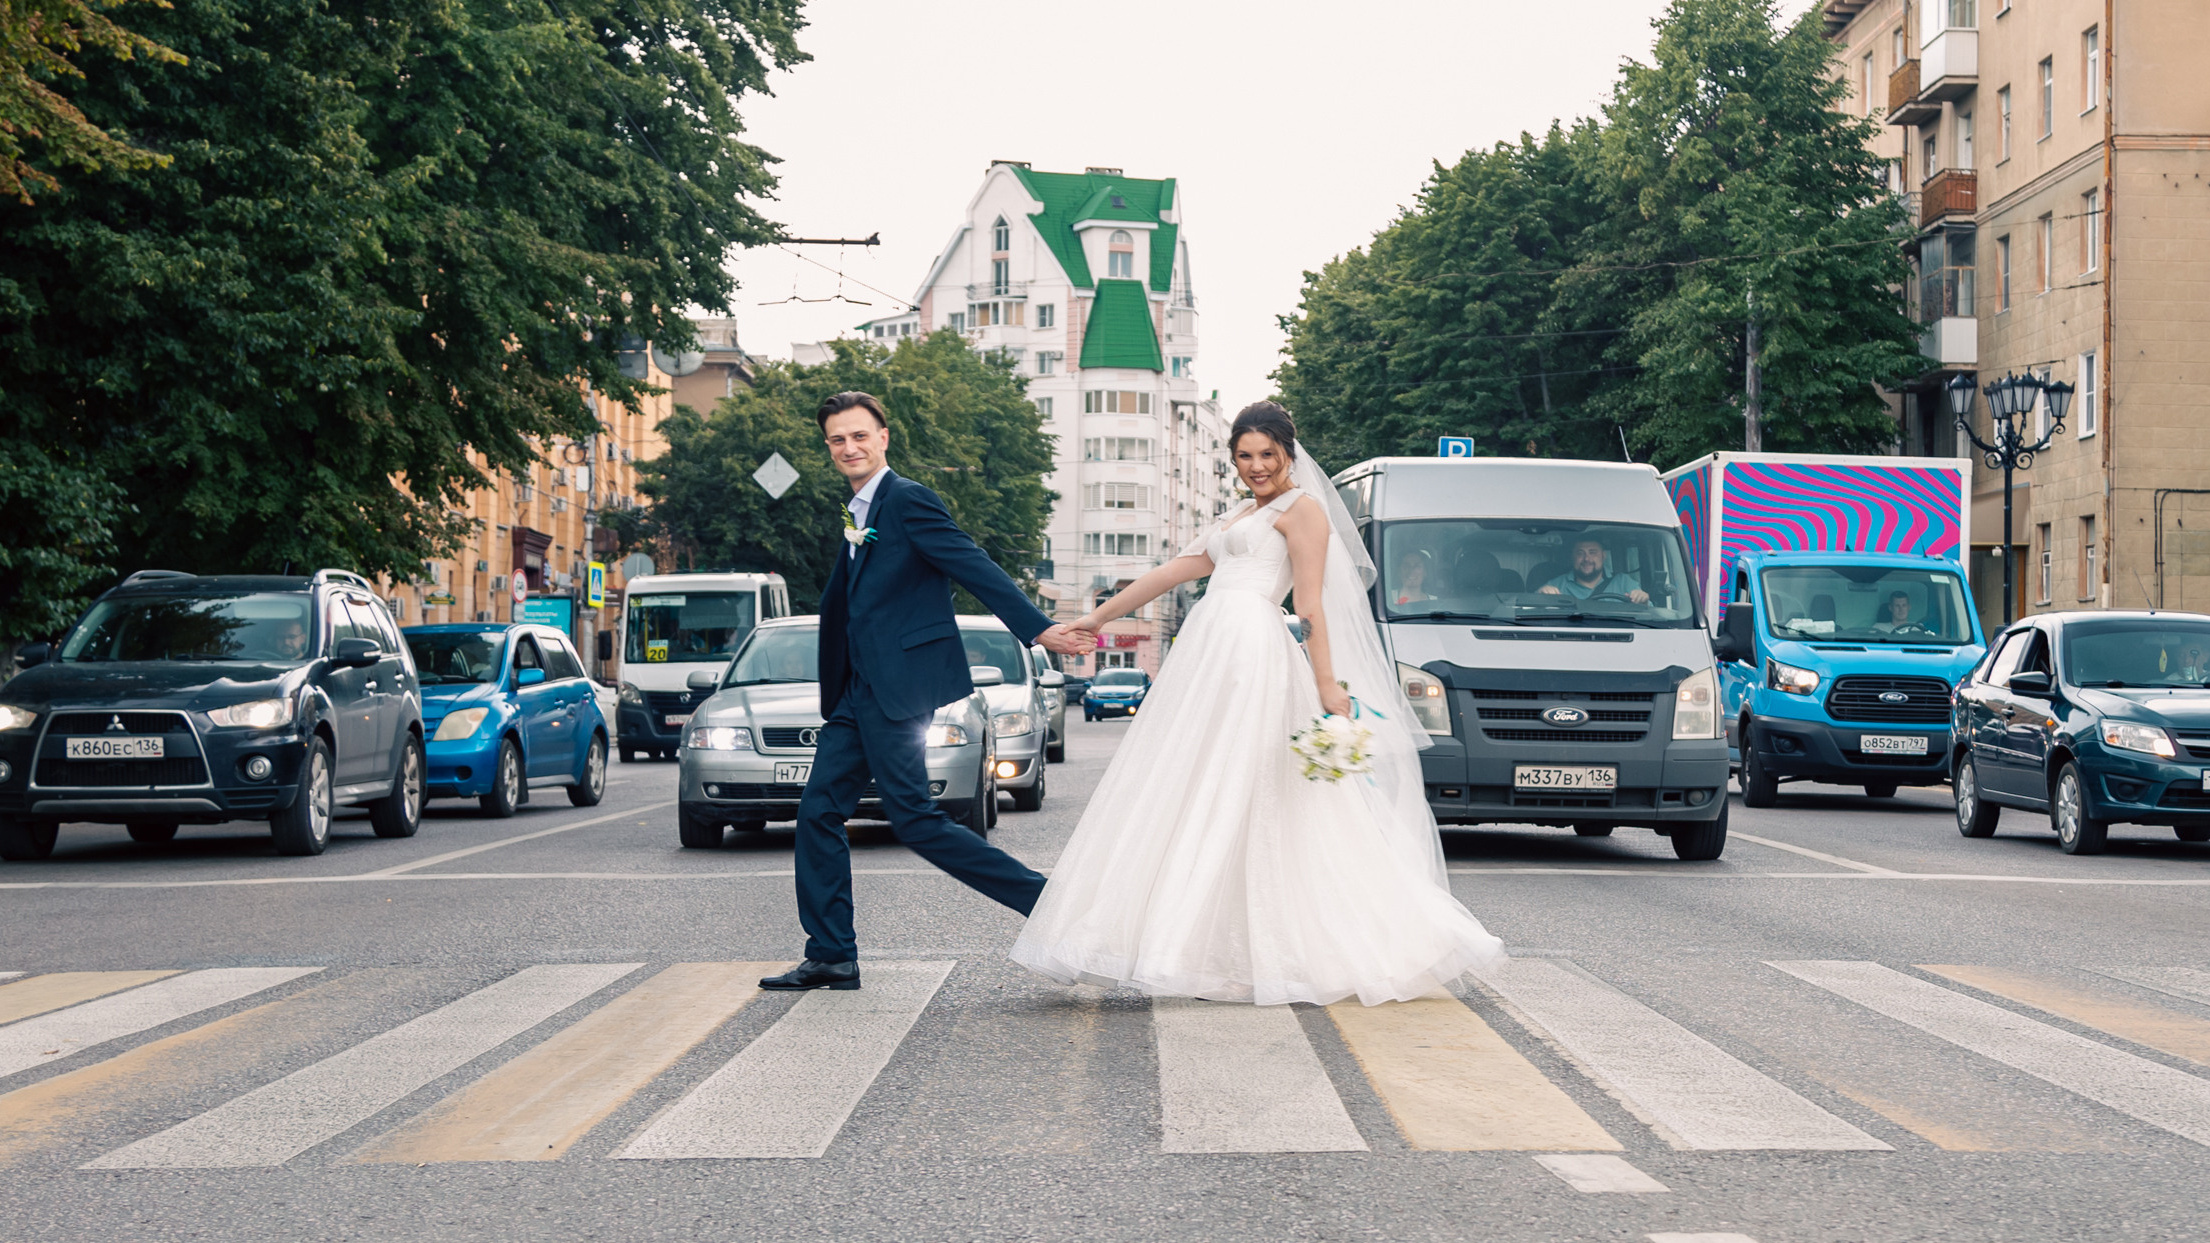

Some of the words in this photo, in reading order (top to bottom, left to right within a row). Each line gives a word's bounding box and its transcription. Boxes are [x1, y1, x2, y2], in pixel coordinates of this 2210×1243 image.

[1448, 441, 1467, 457] P
[649, 649, 667, 660] 20
[1553, 710, 1579, 721] Ford
[72, 741, 133, 755] К860ЕС
[135, 739, 159, 751] 136
[1908, 738, 1925, 747] 797
[780, 765, 810, 780] Н77
[1519, 769, 1583, 785] М337ВУ
[1588, 769, 1612, 782] 136
